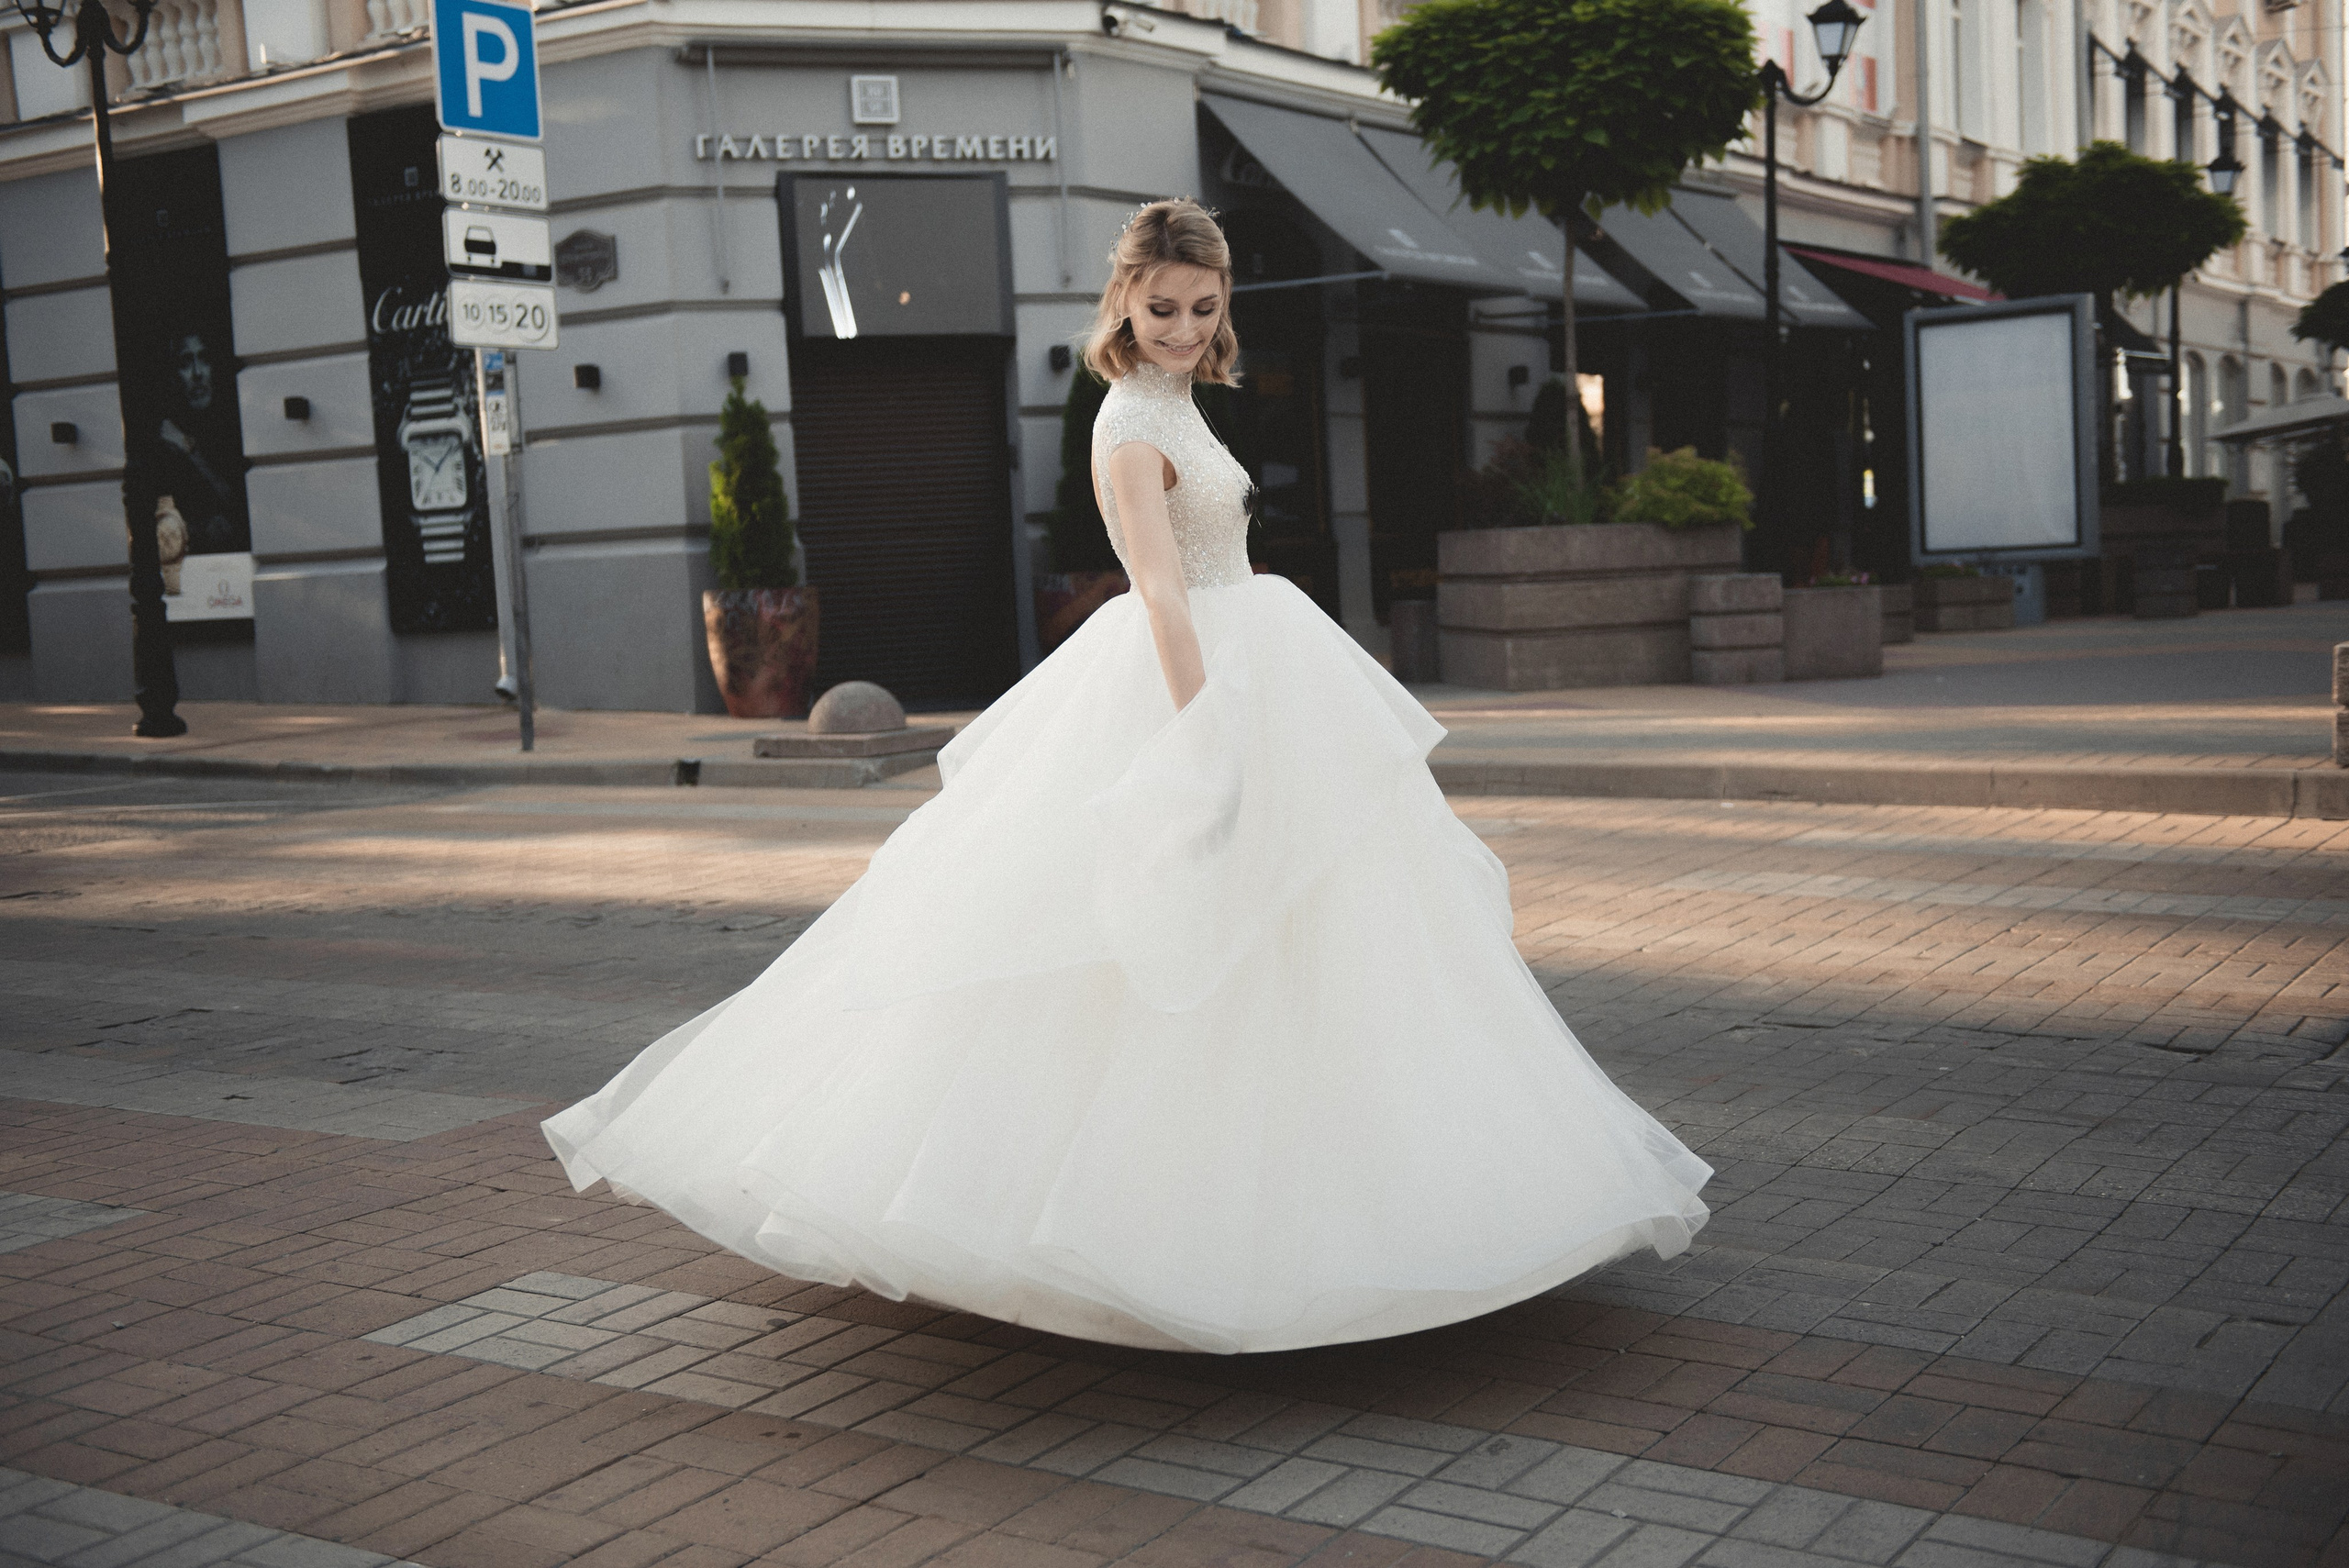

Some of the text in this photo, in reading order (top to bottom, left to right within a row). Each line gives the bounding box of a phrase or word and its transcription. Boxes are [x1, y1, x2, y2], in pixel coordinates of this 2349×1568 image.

[462, 11, 519, 118] P
[696, 133, 1057, 160] ГАЛЕРЕЯ ВРЕМЕНИ
[372, 286, 447, 334] Carti
[463, 302, 545, 329] 10 15 20
